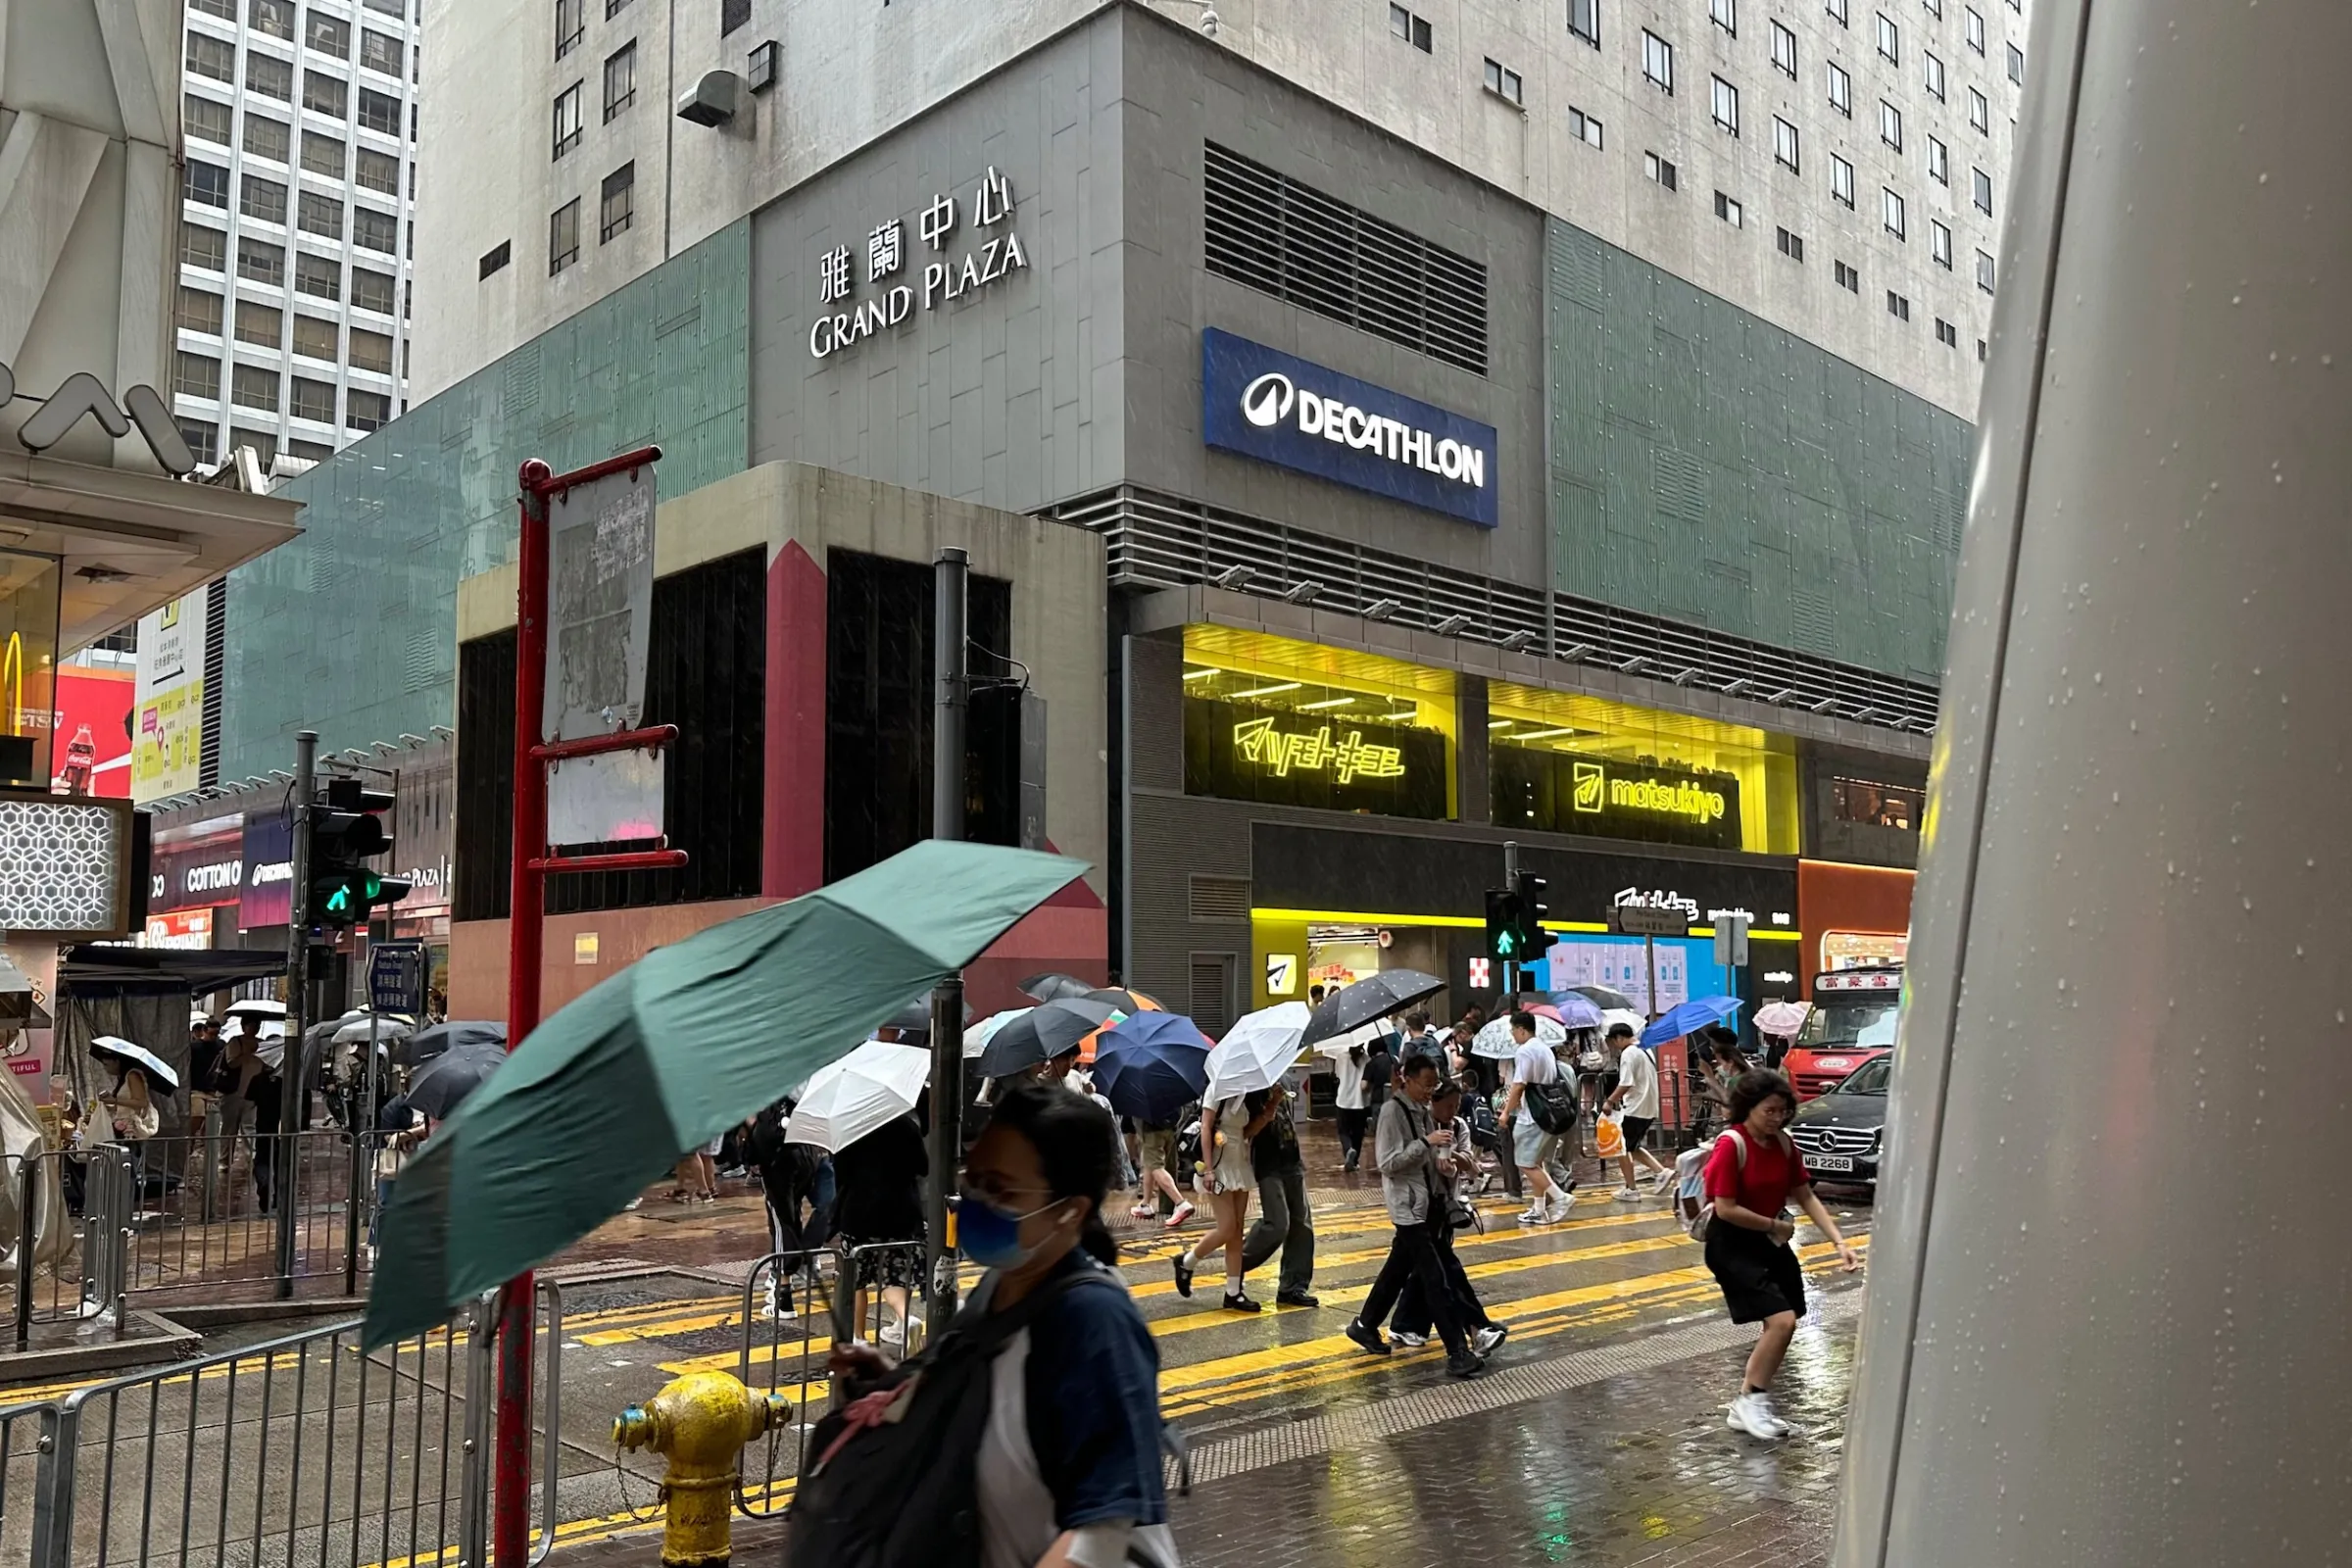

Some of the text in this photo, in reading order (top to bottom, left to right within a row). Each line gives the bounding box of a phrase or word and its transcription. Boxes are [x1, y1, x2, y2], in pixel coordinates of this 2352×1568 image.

[820, 166, 1014, 304] 雅蘭中心
[809, 231, 1026, 359] GRAND PLAZA
[1298, 389, 1483, 487] DECATHLON
[1611, 778, 1725, 824] matsukiyo
[187, 859, 243, 893] COTTON O
[412, 867, 439, 887] PLAZA
[1820, 1157, 1850, 1169] 2268
